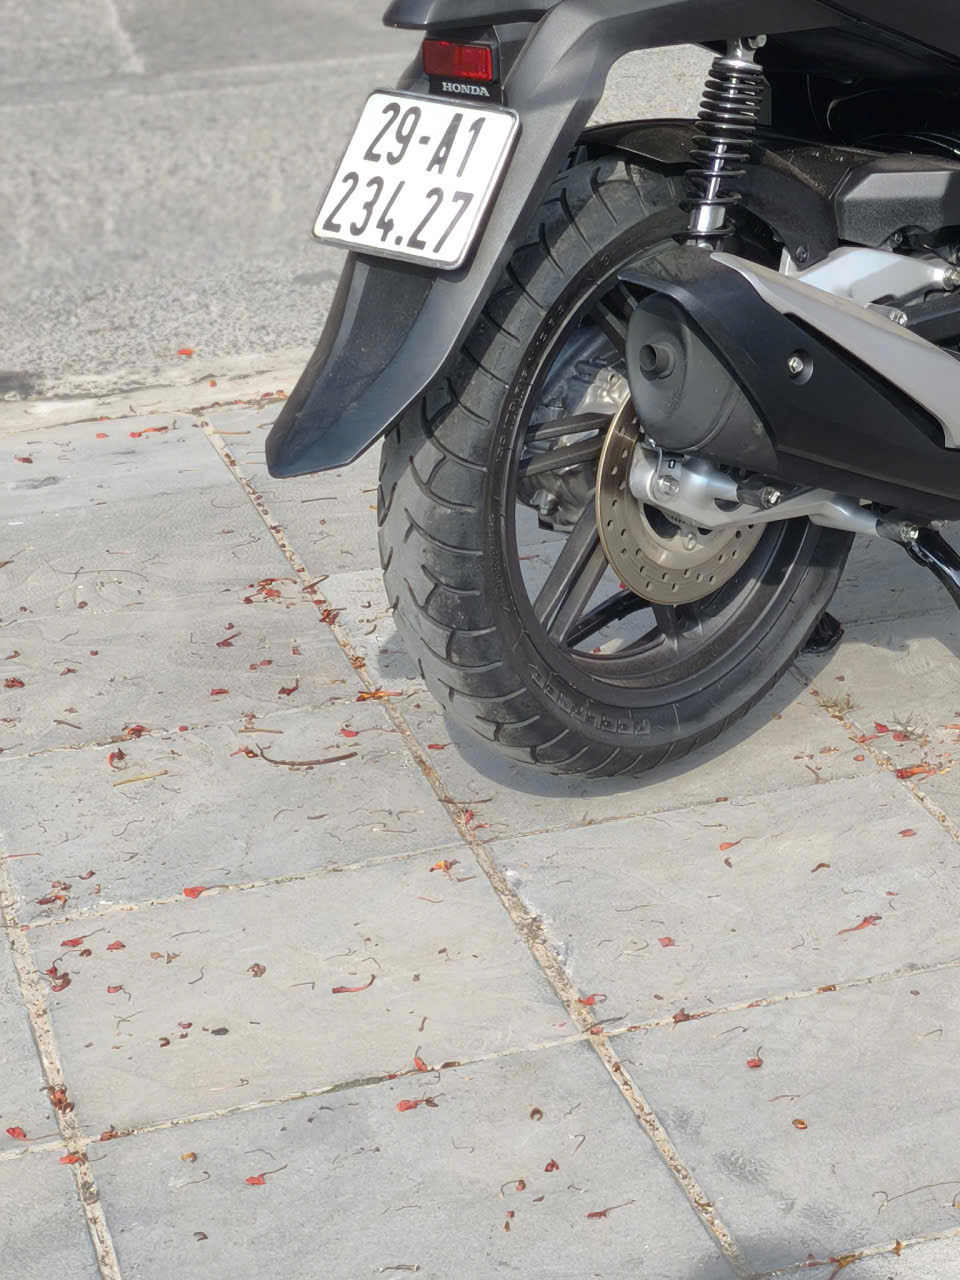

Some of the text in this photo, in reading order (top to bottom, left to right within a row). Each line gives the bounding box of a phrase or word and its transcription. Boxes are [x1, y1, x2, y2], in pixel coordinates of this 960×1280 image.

[441, 81, 490, 97] HONDA
[363, 102, 487, 178] 29-A1
[322, 171, 475, 253] 234.27
